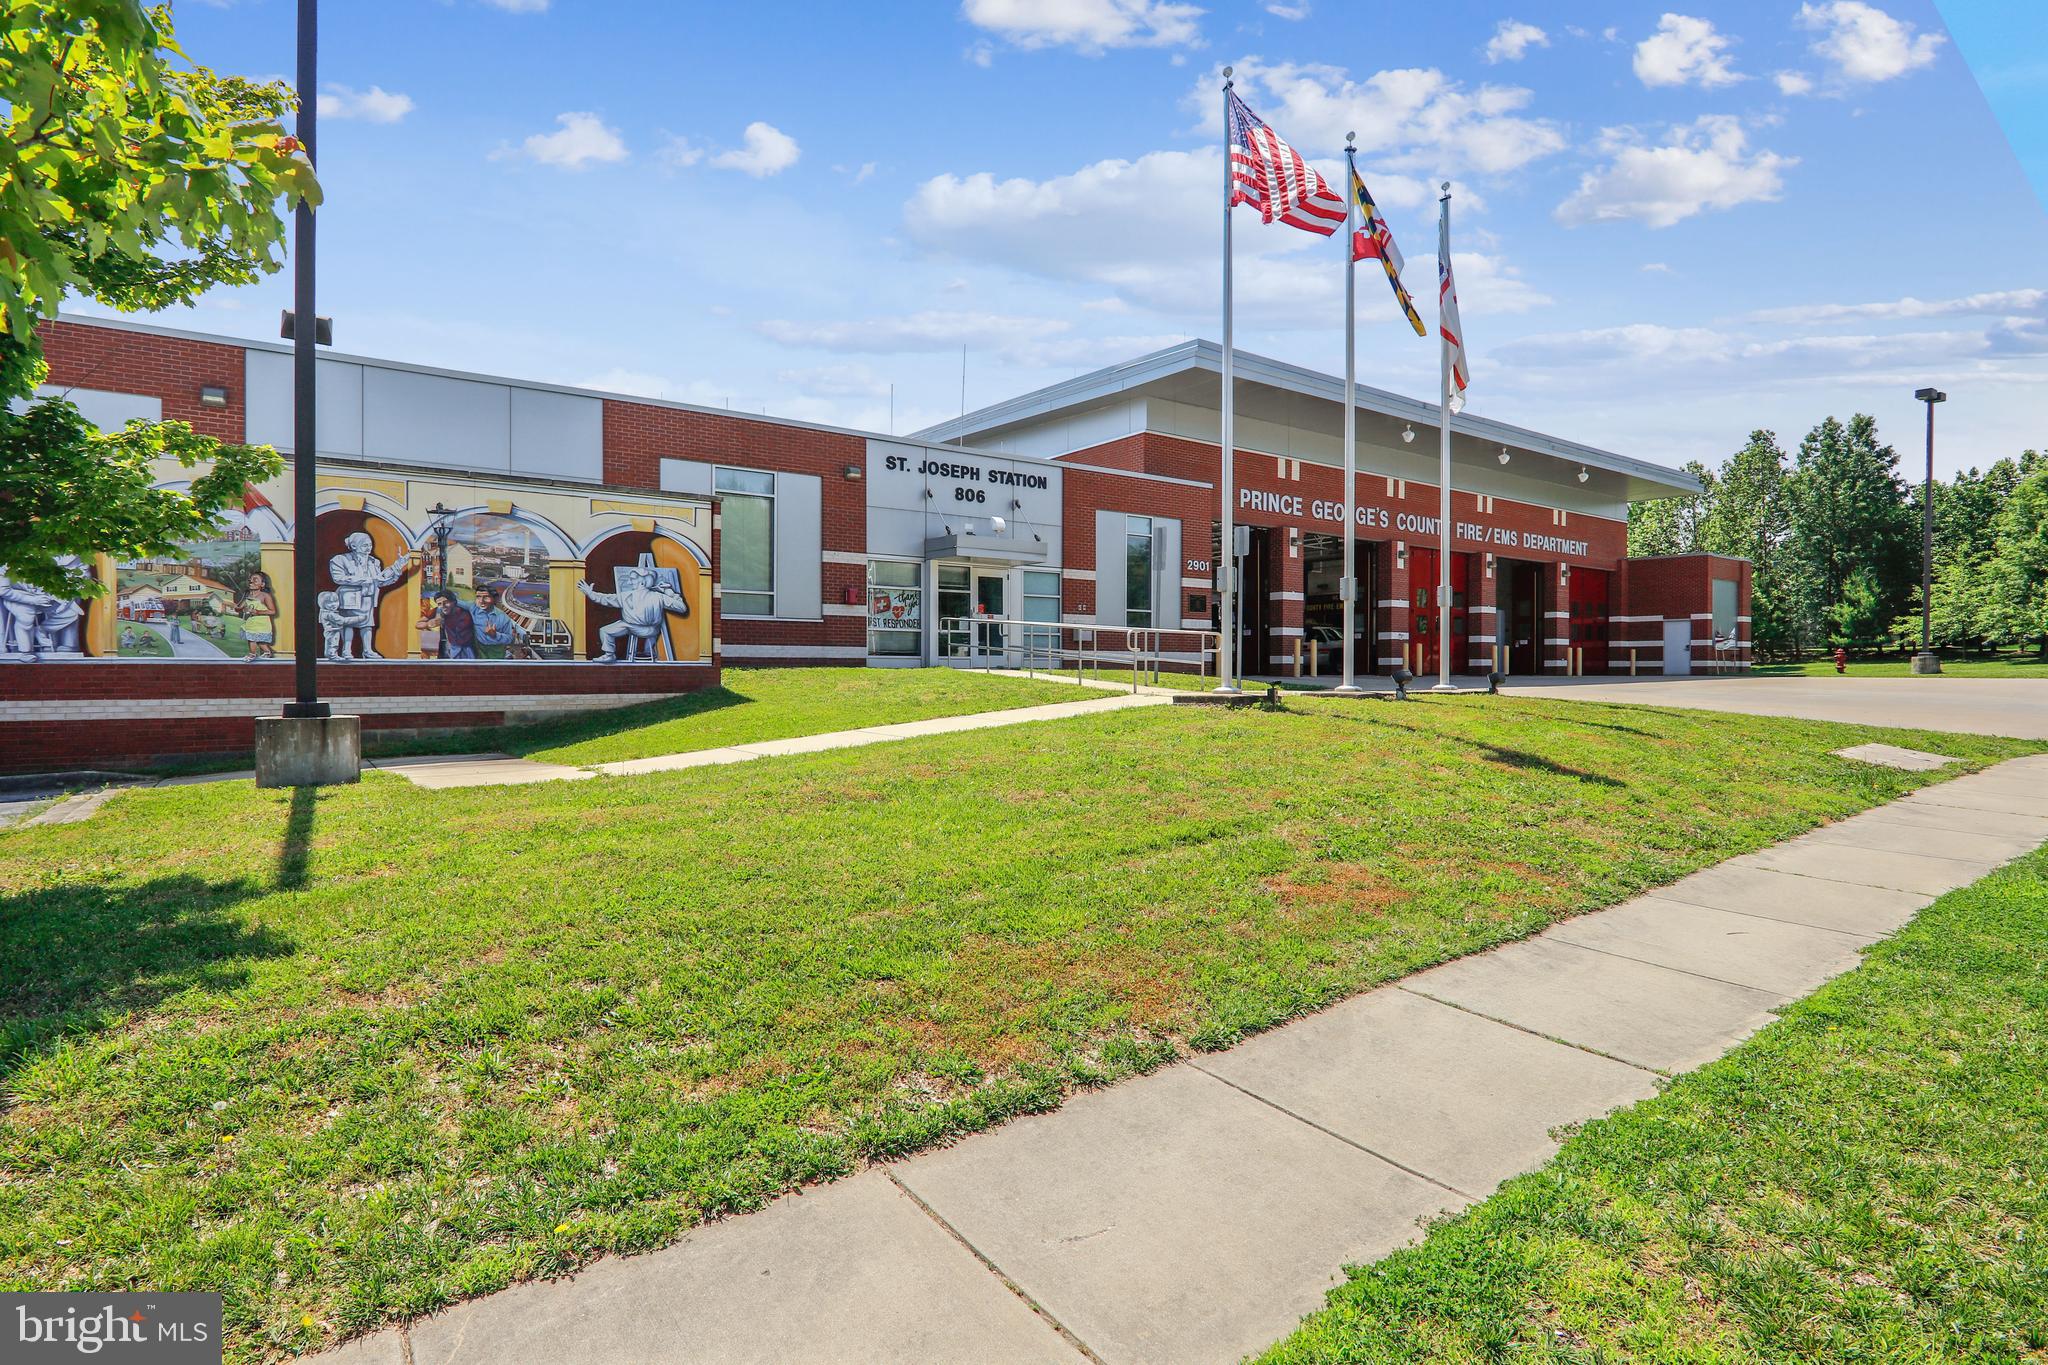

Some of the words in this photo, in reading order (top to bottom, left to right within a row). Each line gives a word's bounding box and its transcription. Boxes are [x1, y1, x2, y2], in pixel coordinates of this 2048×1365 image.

[885, 455, 911, 472] ST.
[918, 460, 980, 481] JOSEPH
[988, 469, 1048, 490] STATION
[954, 487, 986, 504] 806
[1240, 488, 1303, 516] PRINCE
[1311, 500, 1389, 529] GEOGE'S
[1396, 512, 1451, 537] COUNT
[1523, 532, 1589, 557] DEPARTMENT
[1187, 559, 1210, 572] 2901
